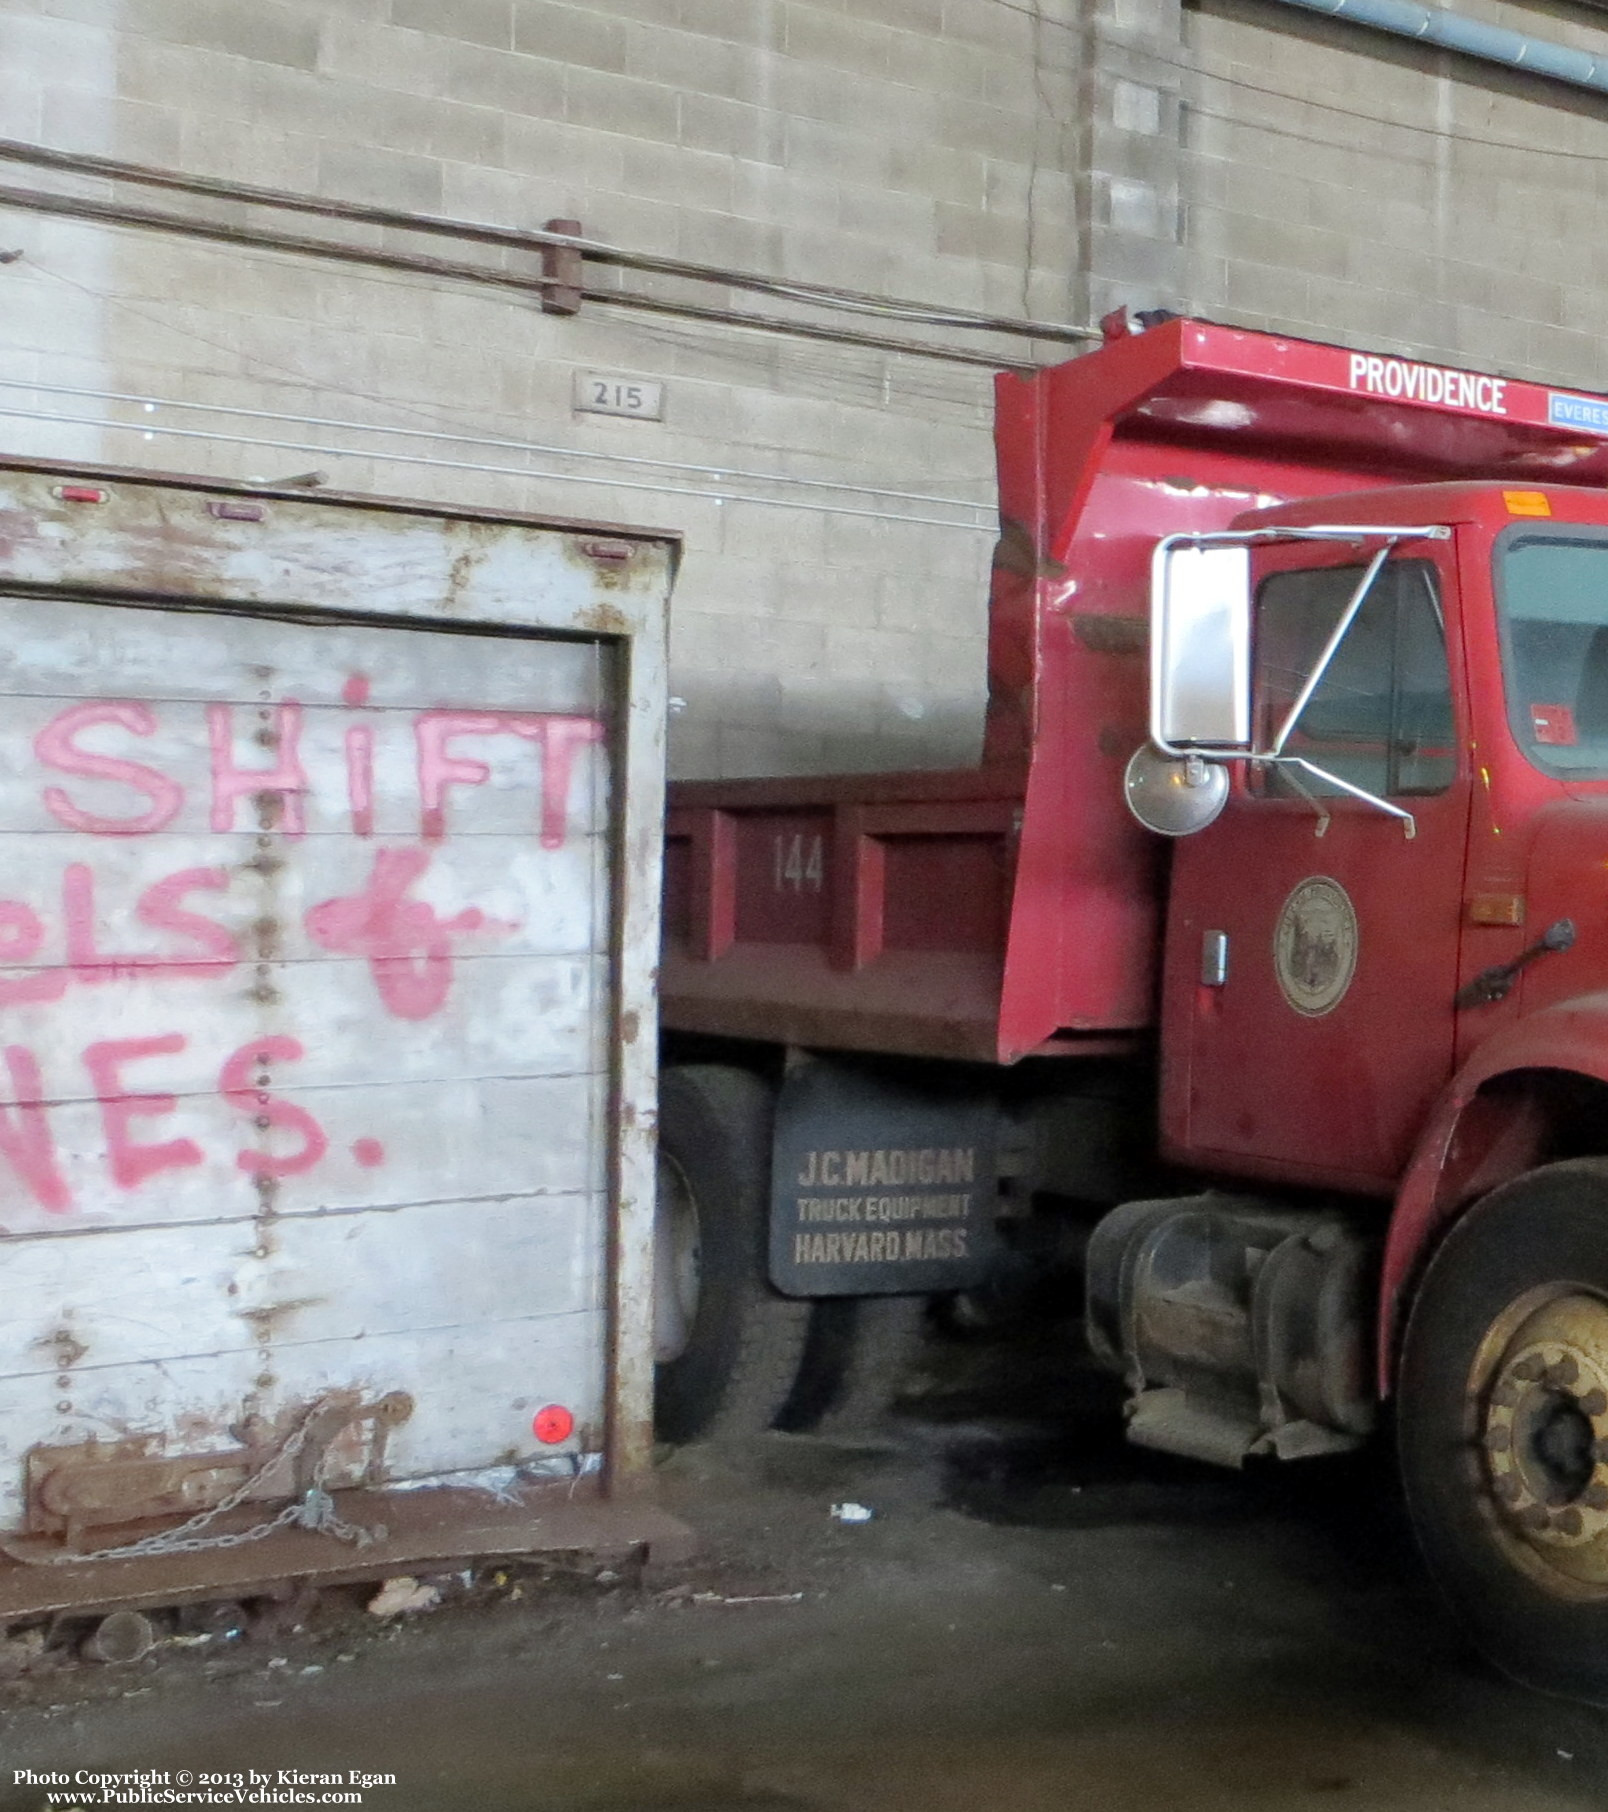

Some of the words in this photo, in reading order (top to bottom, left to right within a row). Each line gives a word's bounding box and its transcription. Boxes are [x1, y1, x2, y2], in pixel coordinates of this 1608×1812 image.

[593, 382, 643, 409] 215
[1350, 355, 1507, 415] PROVIDENCE
[774, 834, 823, 893] 144
[798, 1197, 862, 1221] TRUCK
[865, 1194, 970, 1223] EQUIPMENT
[796, 1231, 900, 1264] HARVARD
